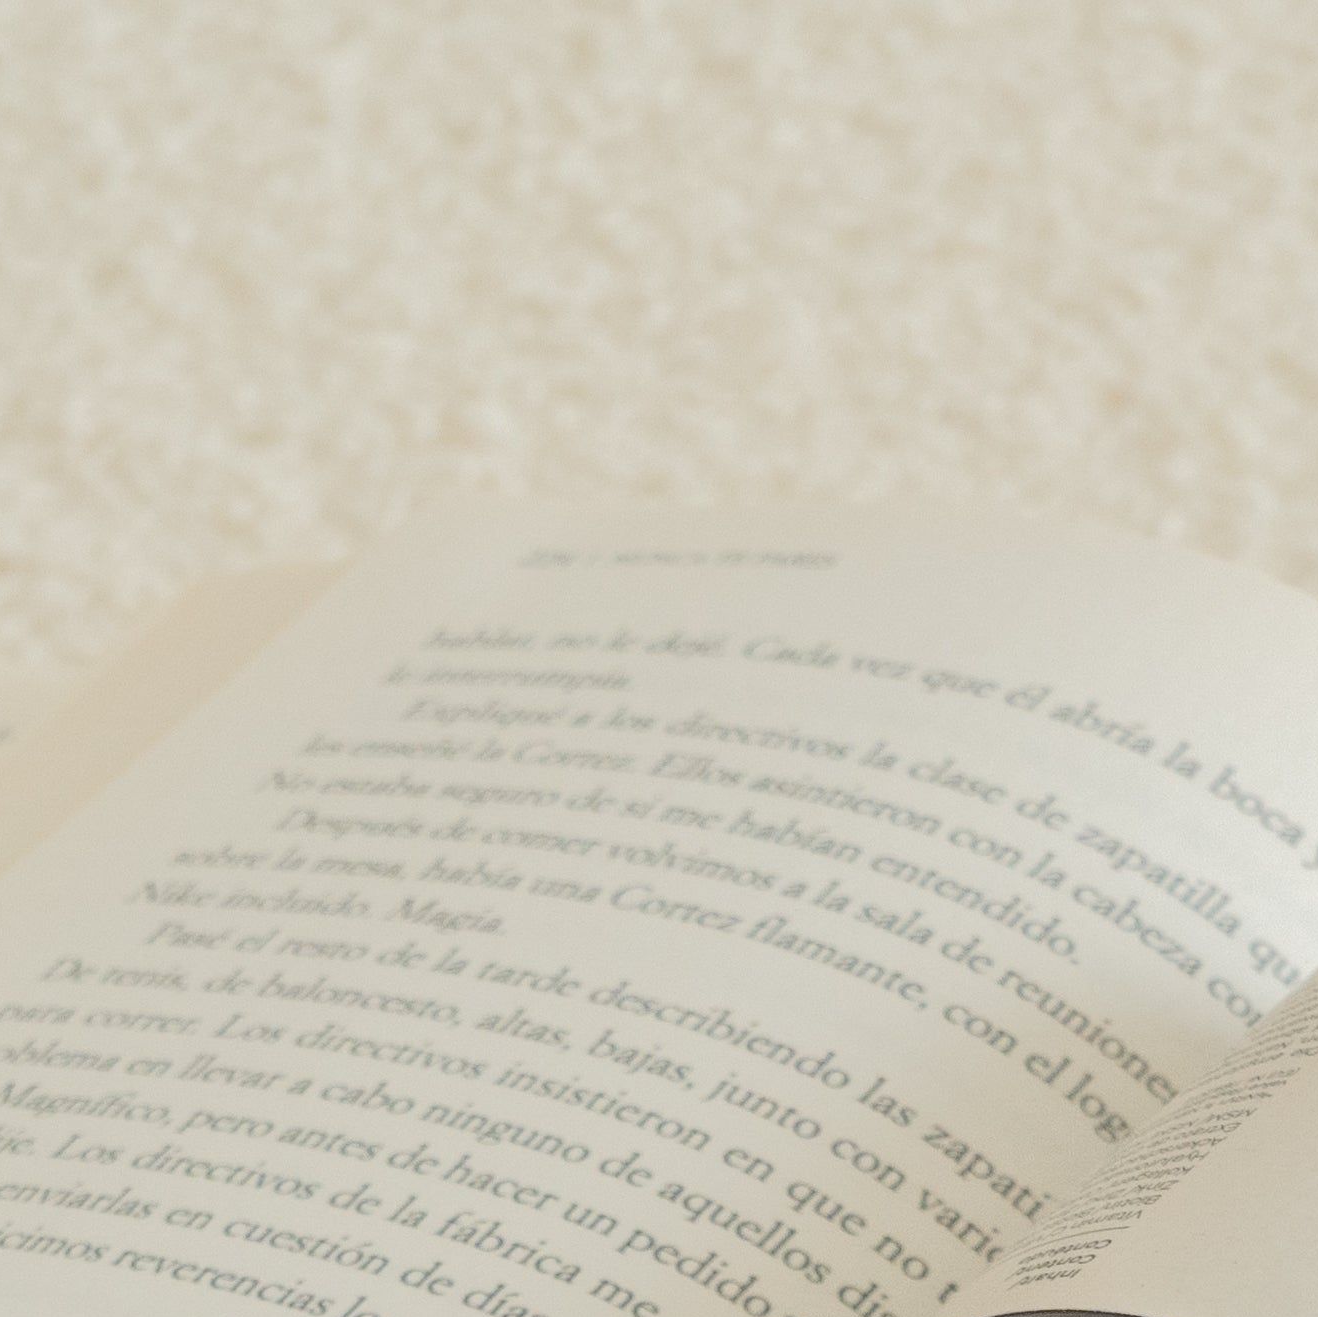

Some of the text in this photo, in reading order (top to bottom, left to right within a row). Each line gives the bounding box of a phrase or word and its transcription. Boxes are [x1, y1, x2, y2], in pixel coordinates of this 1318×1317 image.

[1048, 700, 1156, 757] abría
[1161, 740, 1203, 781] la
[1207, 765, 1307, 850] boca
[906, 758, 1243, 939] clase de zapatilla
[869, 855, 1077, 957] entendido.
[586, 979, 918, 1128] describiendo las
[221, 1220, 391, 1277] cuestión
[398, 1259, 456, 1297] de
[561, 1201, 620, 1238] un
[110, 1248, 335, 1317] reverencias
